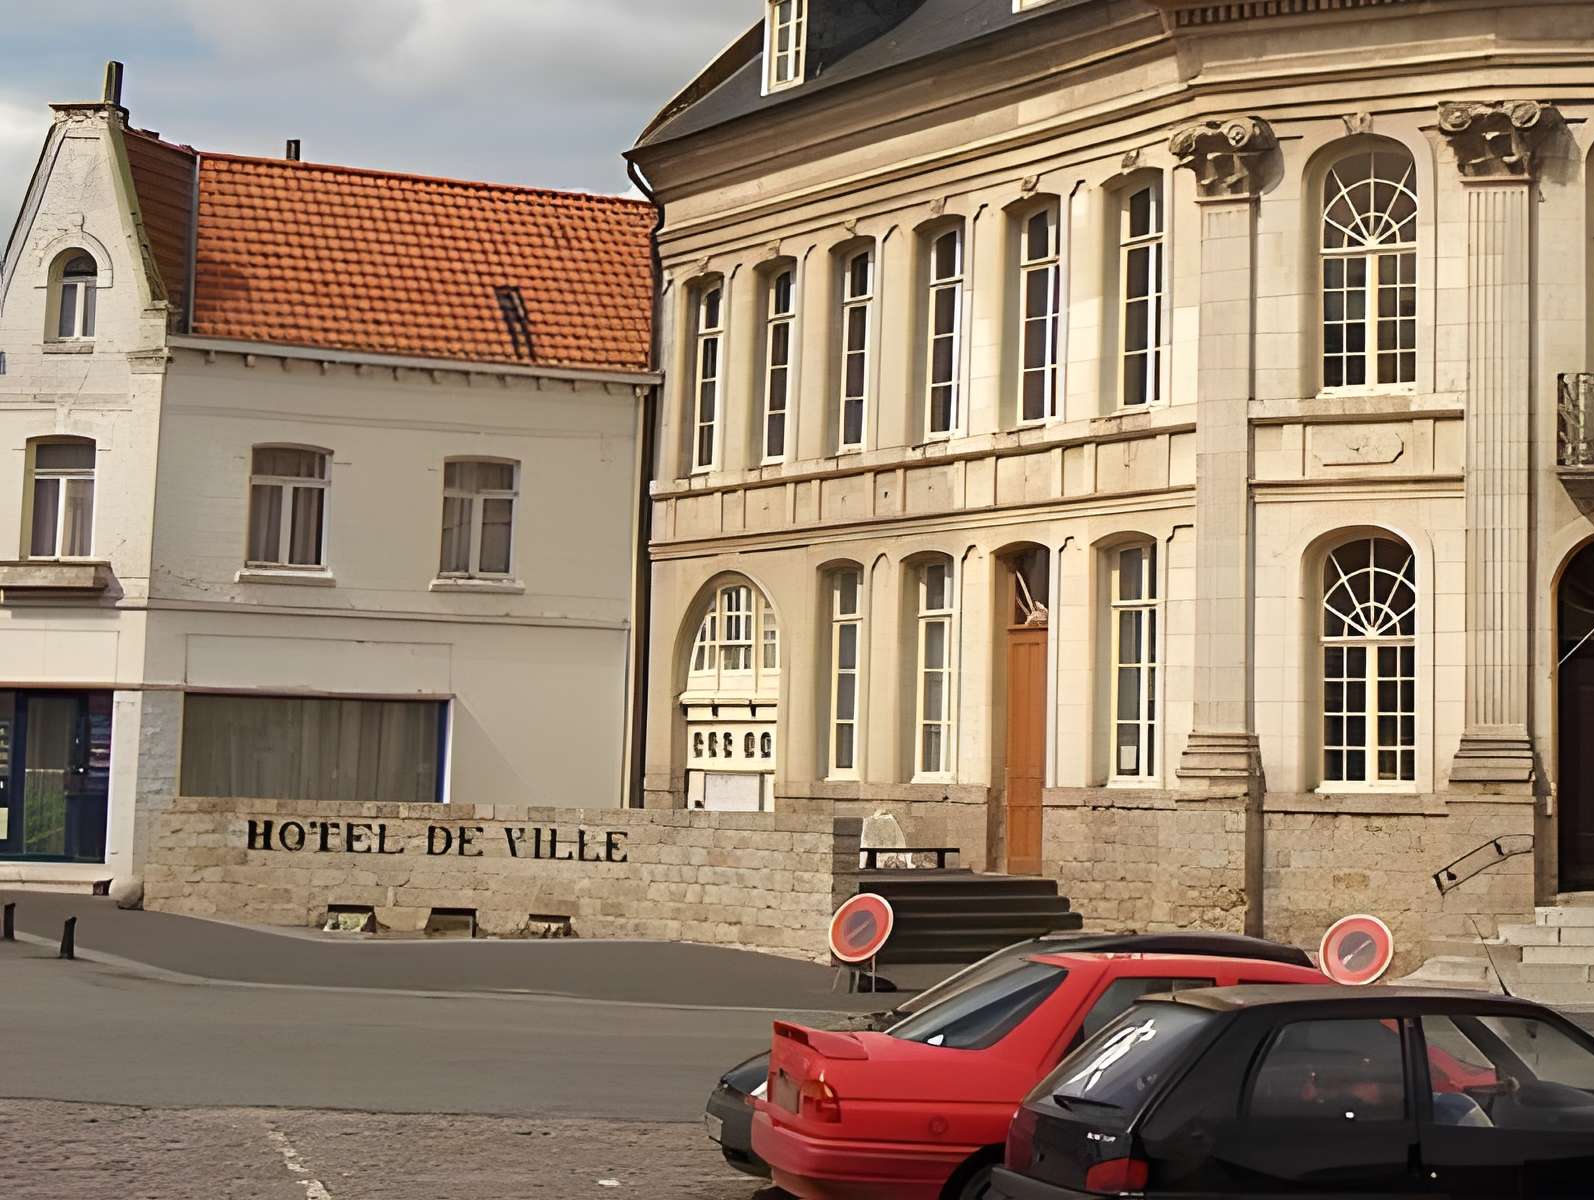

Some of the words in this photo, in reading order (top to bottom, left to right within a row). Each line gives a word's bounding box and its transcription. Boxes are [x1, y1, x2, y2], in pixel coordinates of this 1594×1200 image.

[248, 820, 404, 854] HOTEL
[427, 825, 484, 857] DE
[504, 827, 628, 862] VILLE
